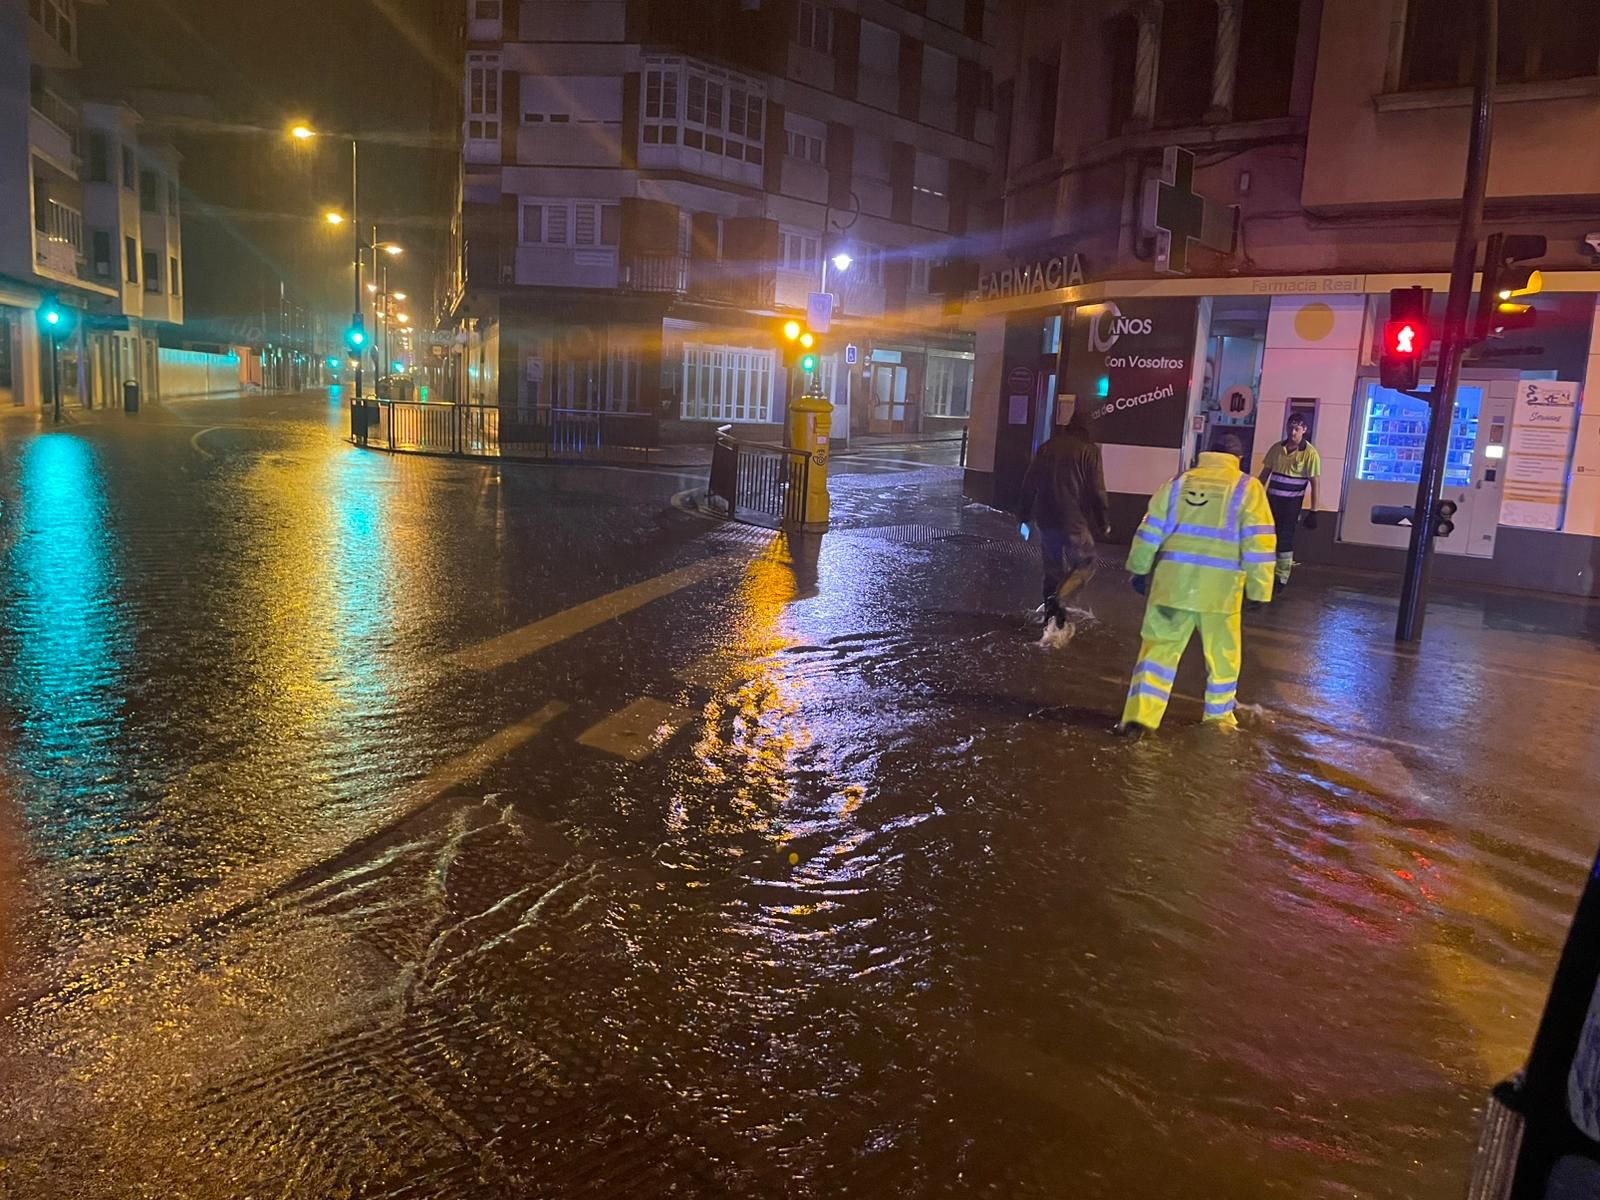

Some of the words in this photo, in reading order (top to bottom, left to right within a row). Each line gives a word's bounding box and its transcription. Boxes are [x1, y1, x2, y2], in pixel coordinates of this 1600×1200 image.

[978, 253, 1084, 300] FARMACIA
[1252, 279, 1317, 293] Farmacia
[1323, 277, 1358, 291] Real
[1108, 315, 1152, 335] AÑOS
[1128, 355, 1184, 370] Vosotros
[1116, 383, 1174, 410] Corazón!
